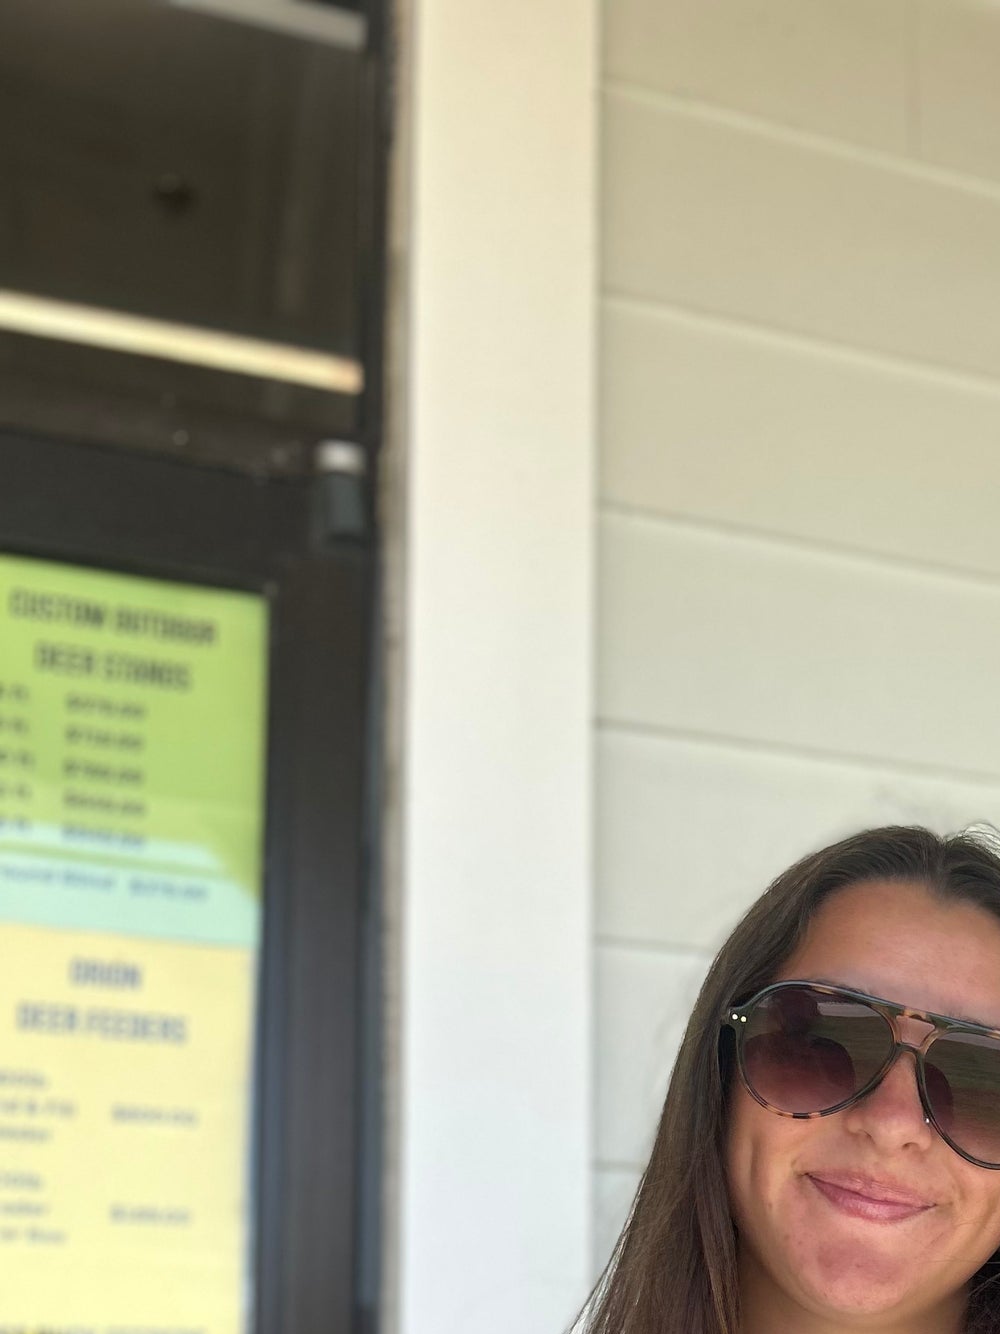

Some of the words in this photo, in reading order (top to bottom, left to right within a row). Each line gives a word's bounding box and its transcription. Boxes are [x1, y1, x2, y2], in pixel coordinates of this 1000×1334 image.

[9, 588, 106, 628] CUSTOM
[35, 641, 94, 677] DEER
[16, 1000, 79, 1034] DEER
[87, 1008, 188, 1043] FEEDERS
